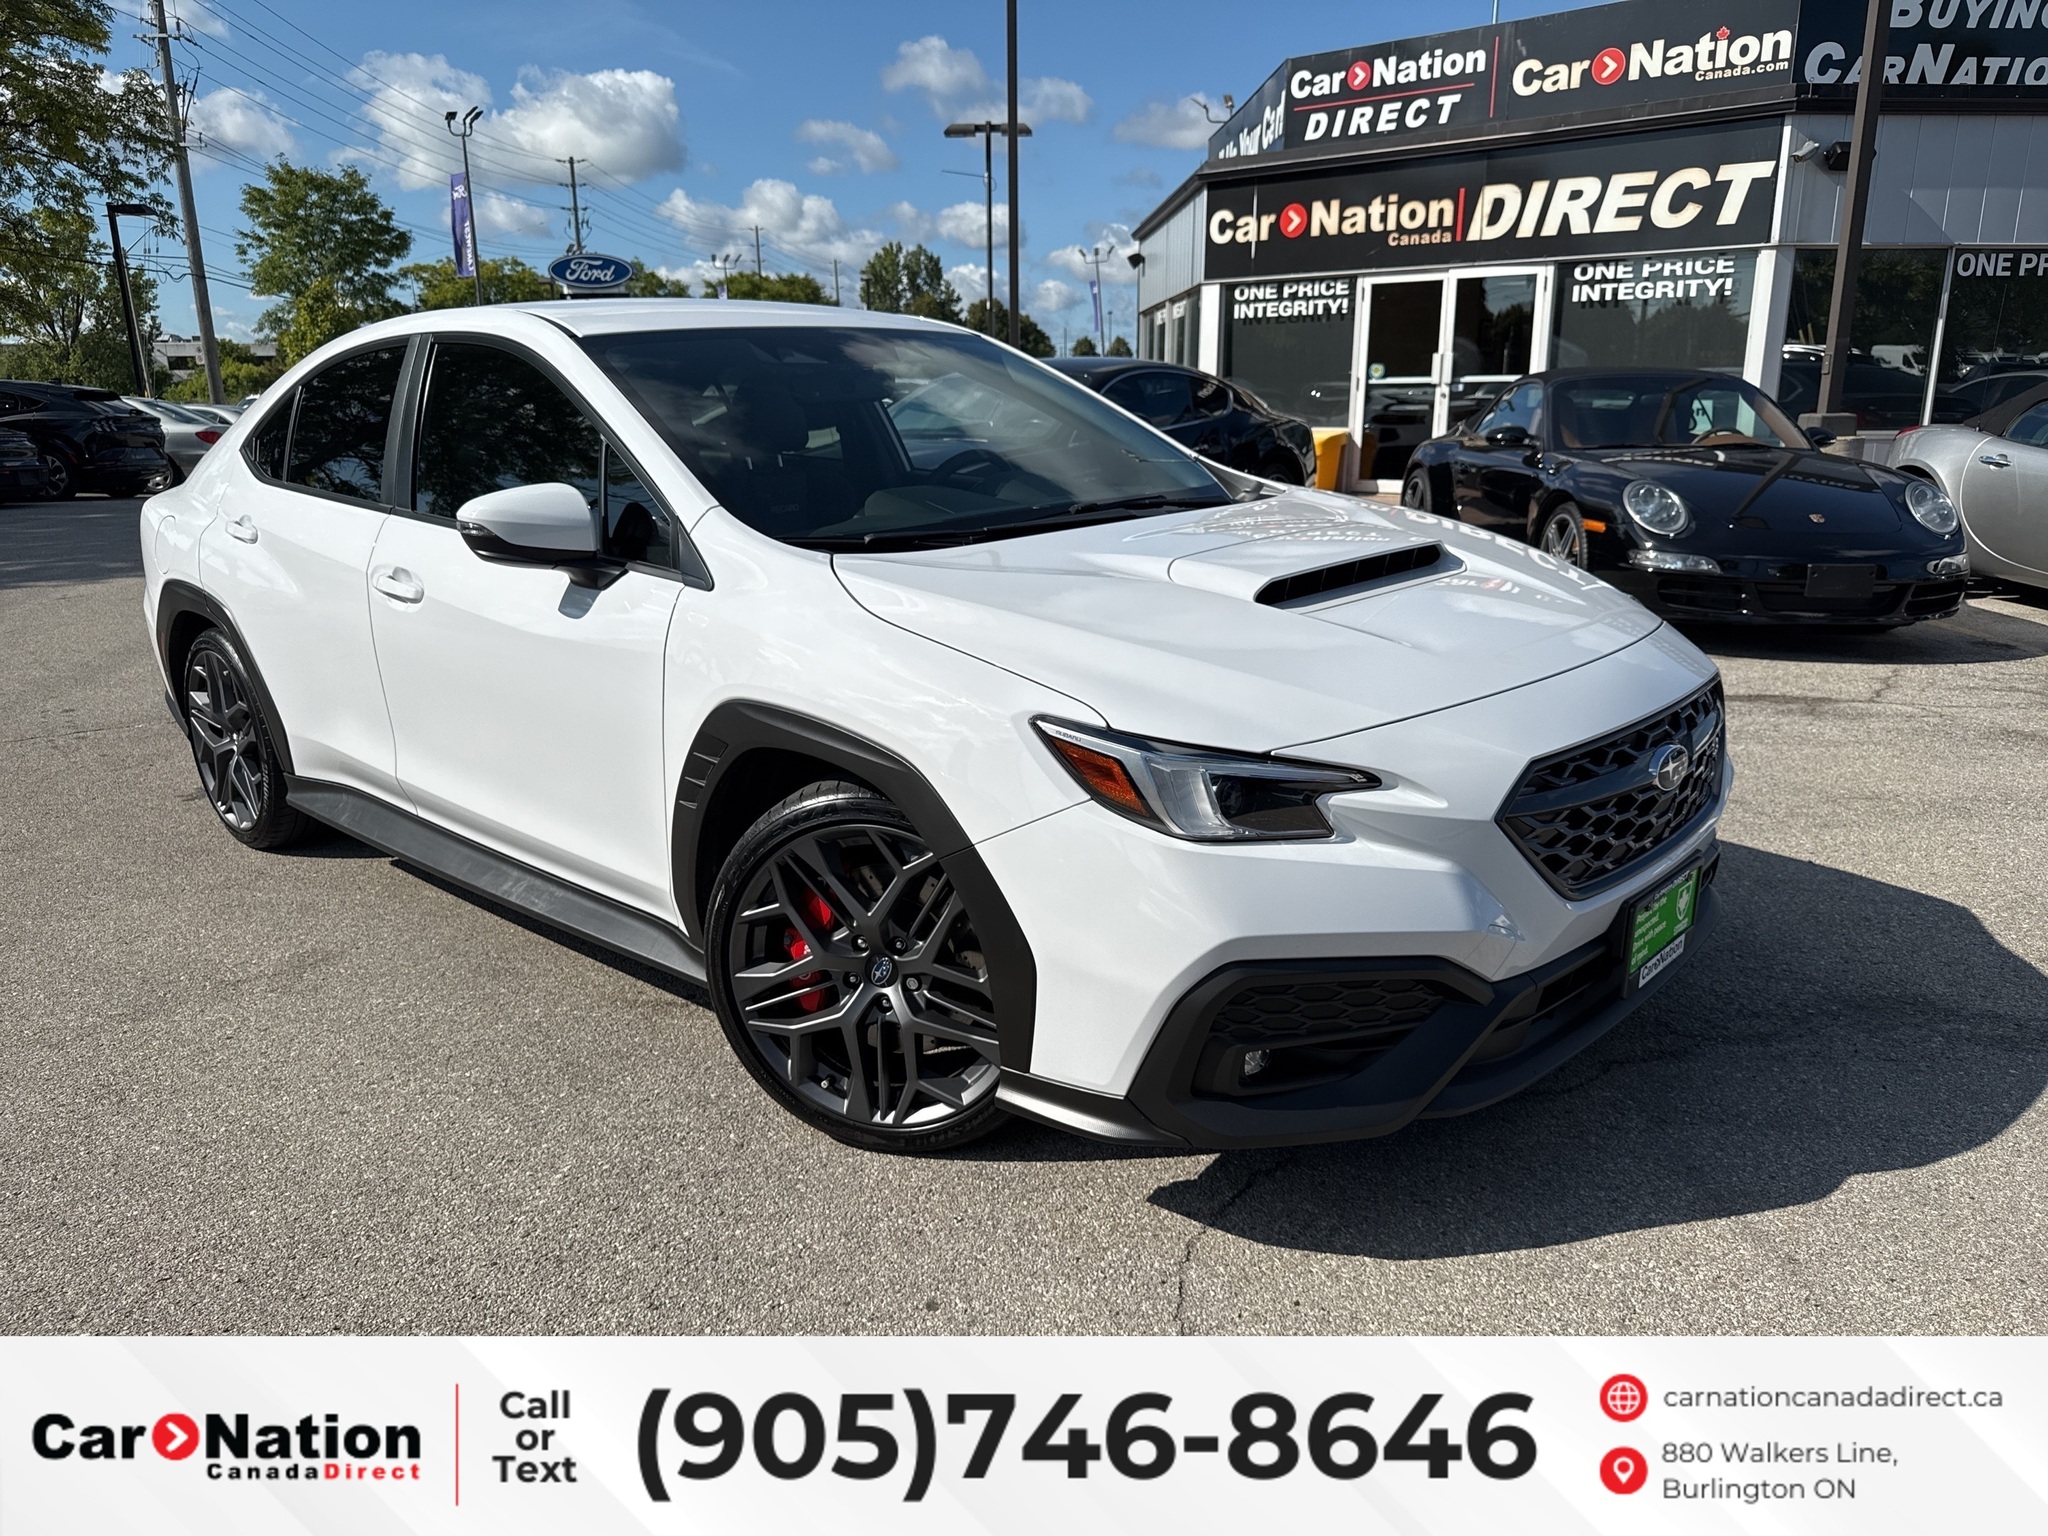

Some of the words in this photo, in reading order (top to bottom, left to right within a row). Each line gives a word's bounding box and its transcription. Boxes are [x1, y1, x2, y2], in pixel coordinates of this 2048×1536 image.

[1889, 0, 2048, 28] BUYIN
[1290, 69, 1347, 99] Car
[1372, 48, 1487, 88] Nation
[1511, 58, 1591, 97] Car
[1628, 28, 1793, 81] Nation
[1694, 61, 1789, 81] Canada.com
[1304, 93, 1463, 141] DIRECT
[1209, 208, 1277, 245] Car
[1310, 193, 1455, 237] Nation
[1466, 160, 1776, 242] DIRECT
[1387, 229, 1453, 247] Canada
[565, 258, 615, 282] Ford
[1573, 262, 1634, 281] ONE
[1641, 255, 1736, 278] PRICE
[1957, 252, 2014, 277] ONE
[1233, 283, 1279, 301] ONE
[1282, 278, 1350, 299] PRICE
[1571, 277, 1733, 302] INTEGRITY!
[1233, 298, 1349, 319] INTEGRITY!
[1055, 730, 1082, 743] SUBARU
